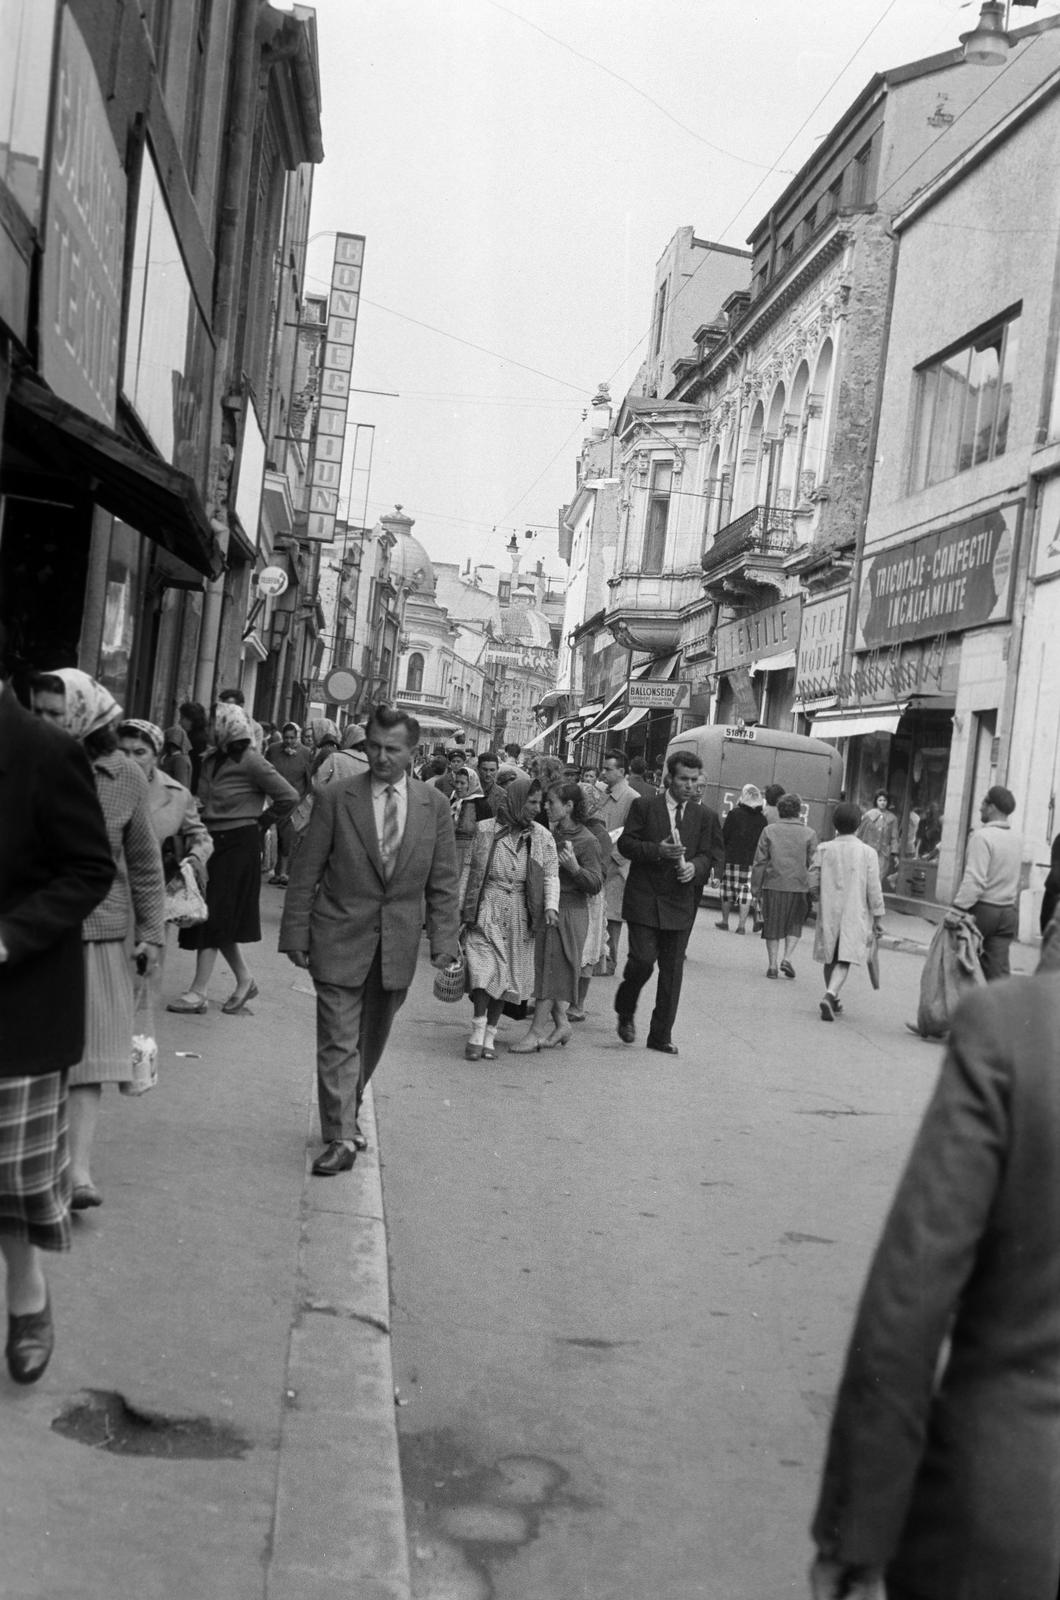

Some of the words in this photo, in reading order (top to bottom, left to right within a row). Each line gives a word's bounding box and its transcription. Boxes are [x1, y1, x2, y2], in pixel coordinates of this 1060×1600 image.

[53, 222, 118, 424] TEXTILE
[875, 554, 927, 598] TRICOTAJE
[729, 610, 789, 660] TEXTILE
[630, 687, 676, 697] BALLONSEIDE
